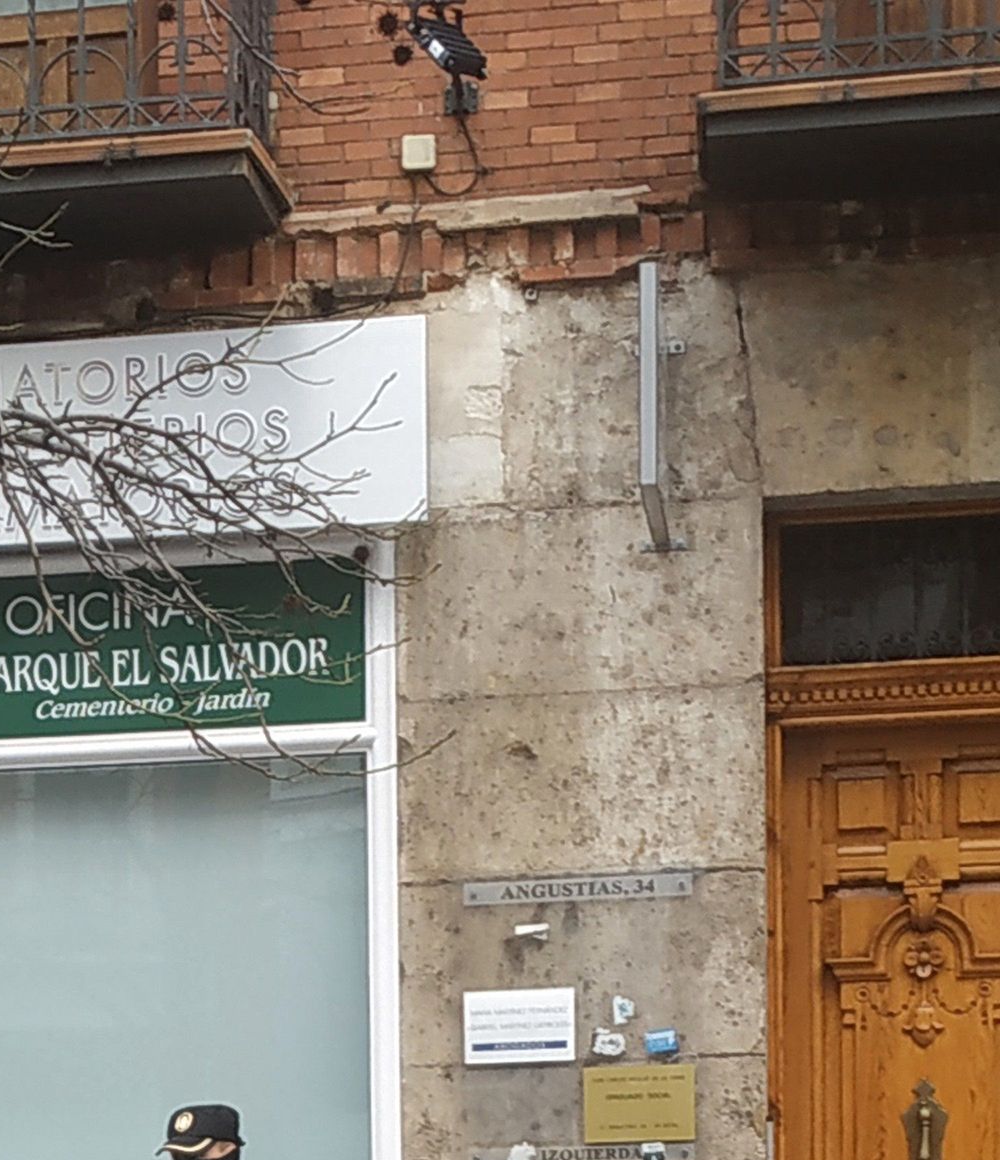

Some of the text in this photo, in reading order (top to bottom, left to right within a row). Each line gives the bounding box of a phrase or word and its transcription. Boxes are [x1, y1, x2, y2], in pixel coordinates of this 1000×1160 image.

[5, 587, 196, 636] OFICINA
[111, 648, 151, 688] EL
[159, 636, 331, 685] SALVADOR
[35, 692, 175, 720] Cementerio
[633, 878, 656, 894] 34
